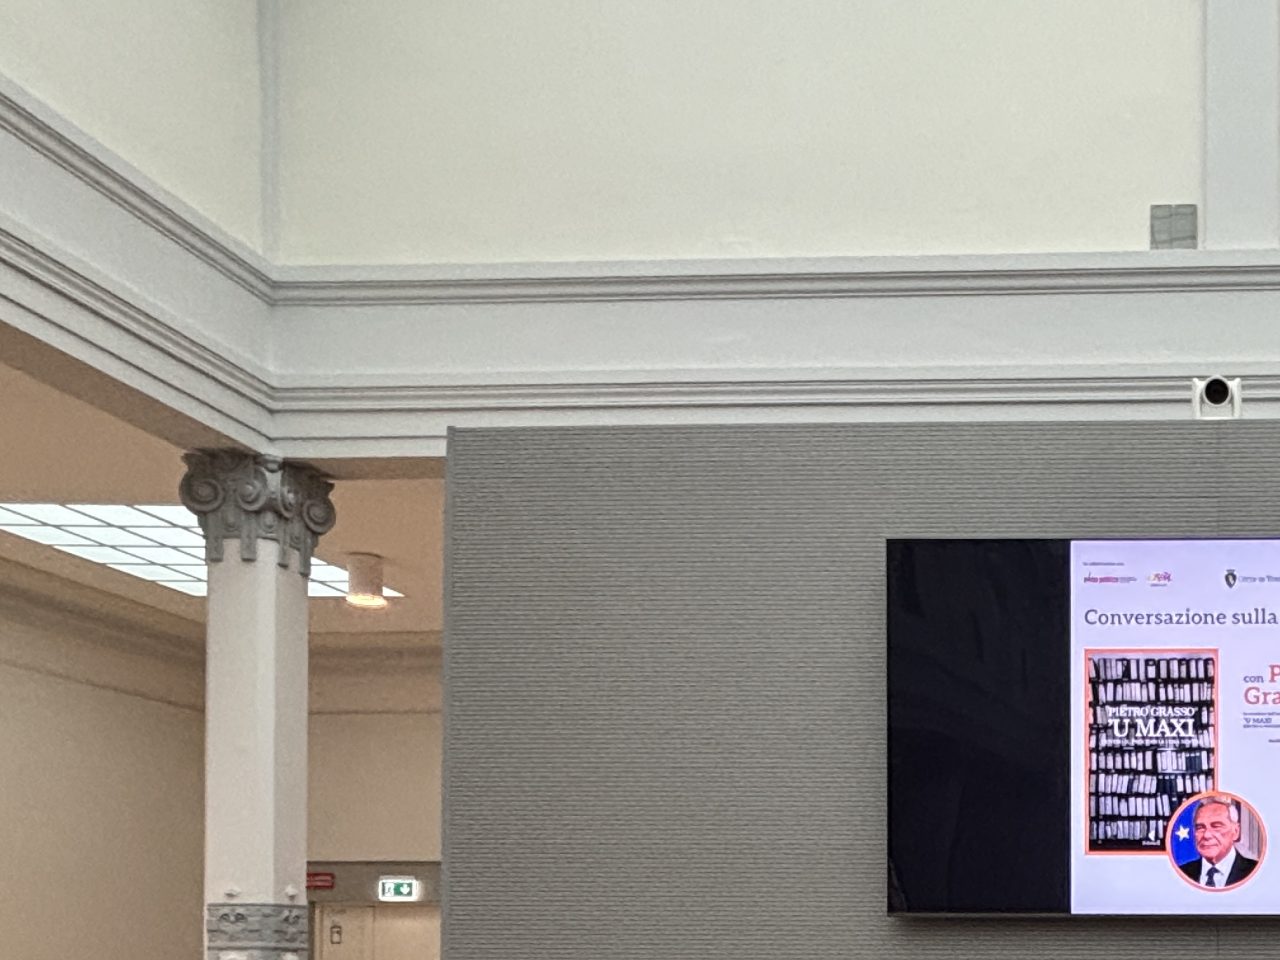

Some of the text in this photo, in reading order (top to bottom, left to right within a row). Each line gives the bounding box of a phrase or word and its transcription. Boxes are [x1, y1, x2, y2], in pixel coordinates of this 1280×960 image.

[1084, 607, 1227, 625] Conversazione
[1231, 608, 1278, 625] sulla
[1243, 675, 1264, 683] con
[1108, 706, 1195, 717] PIETRO GRASSO
[1107, 718, 1195, 738] 'U MAXI
